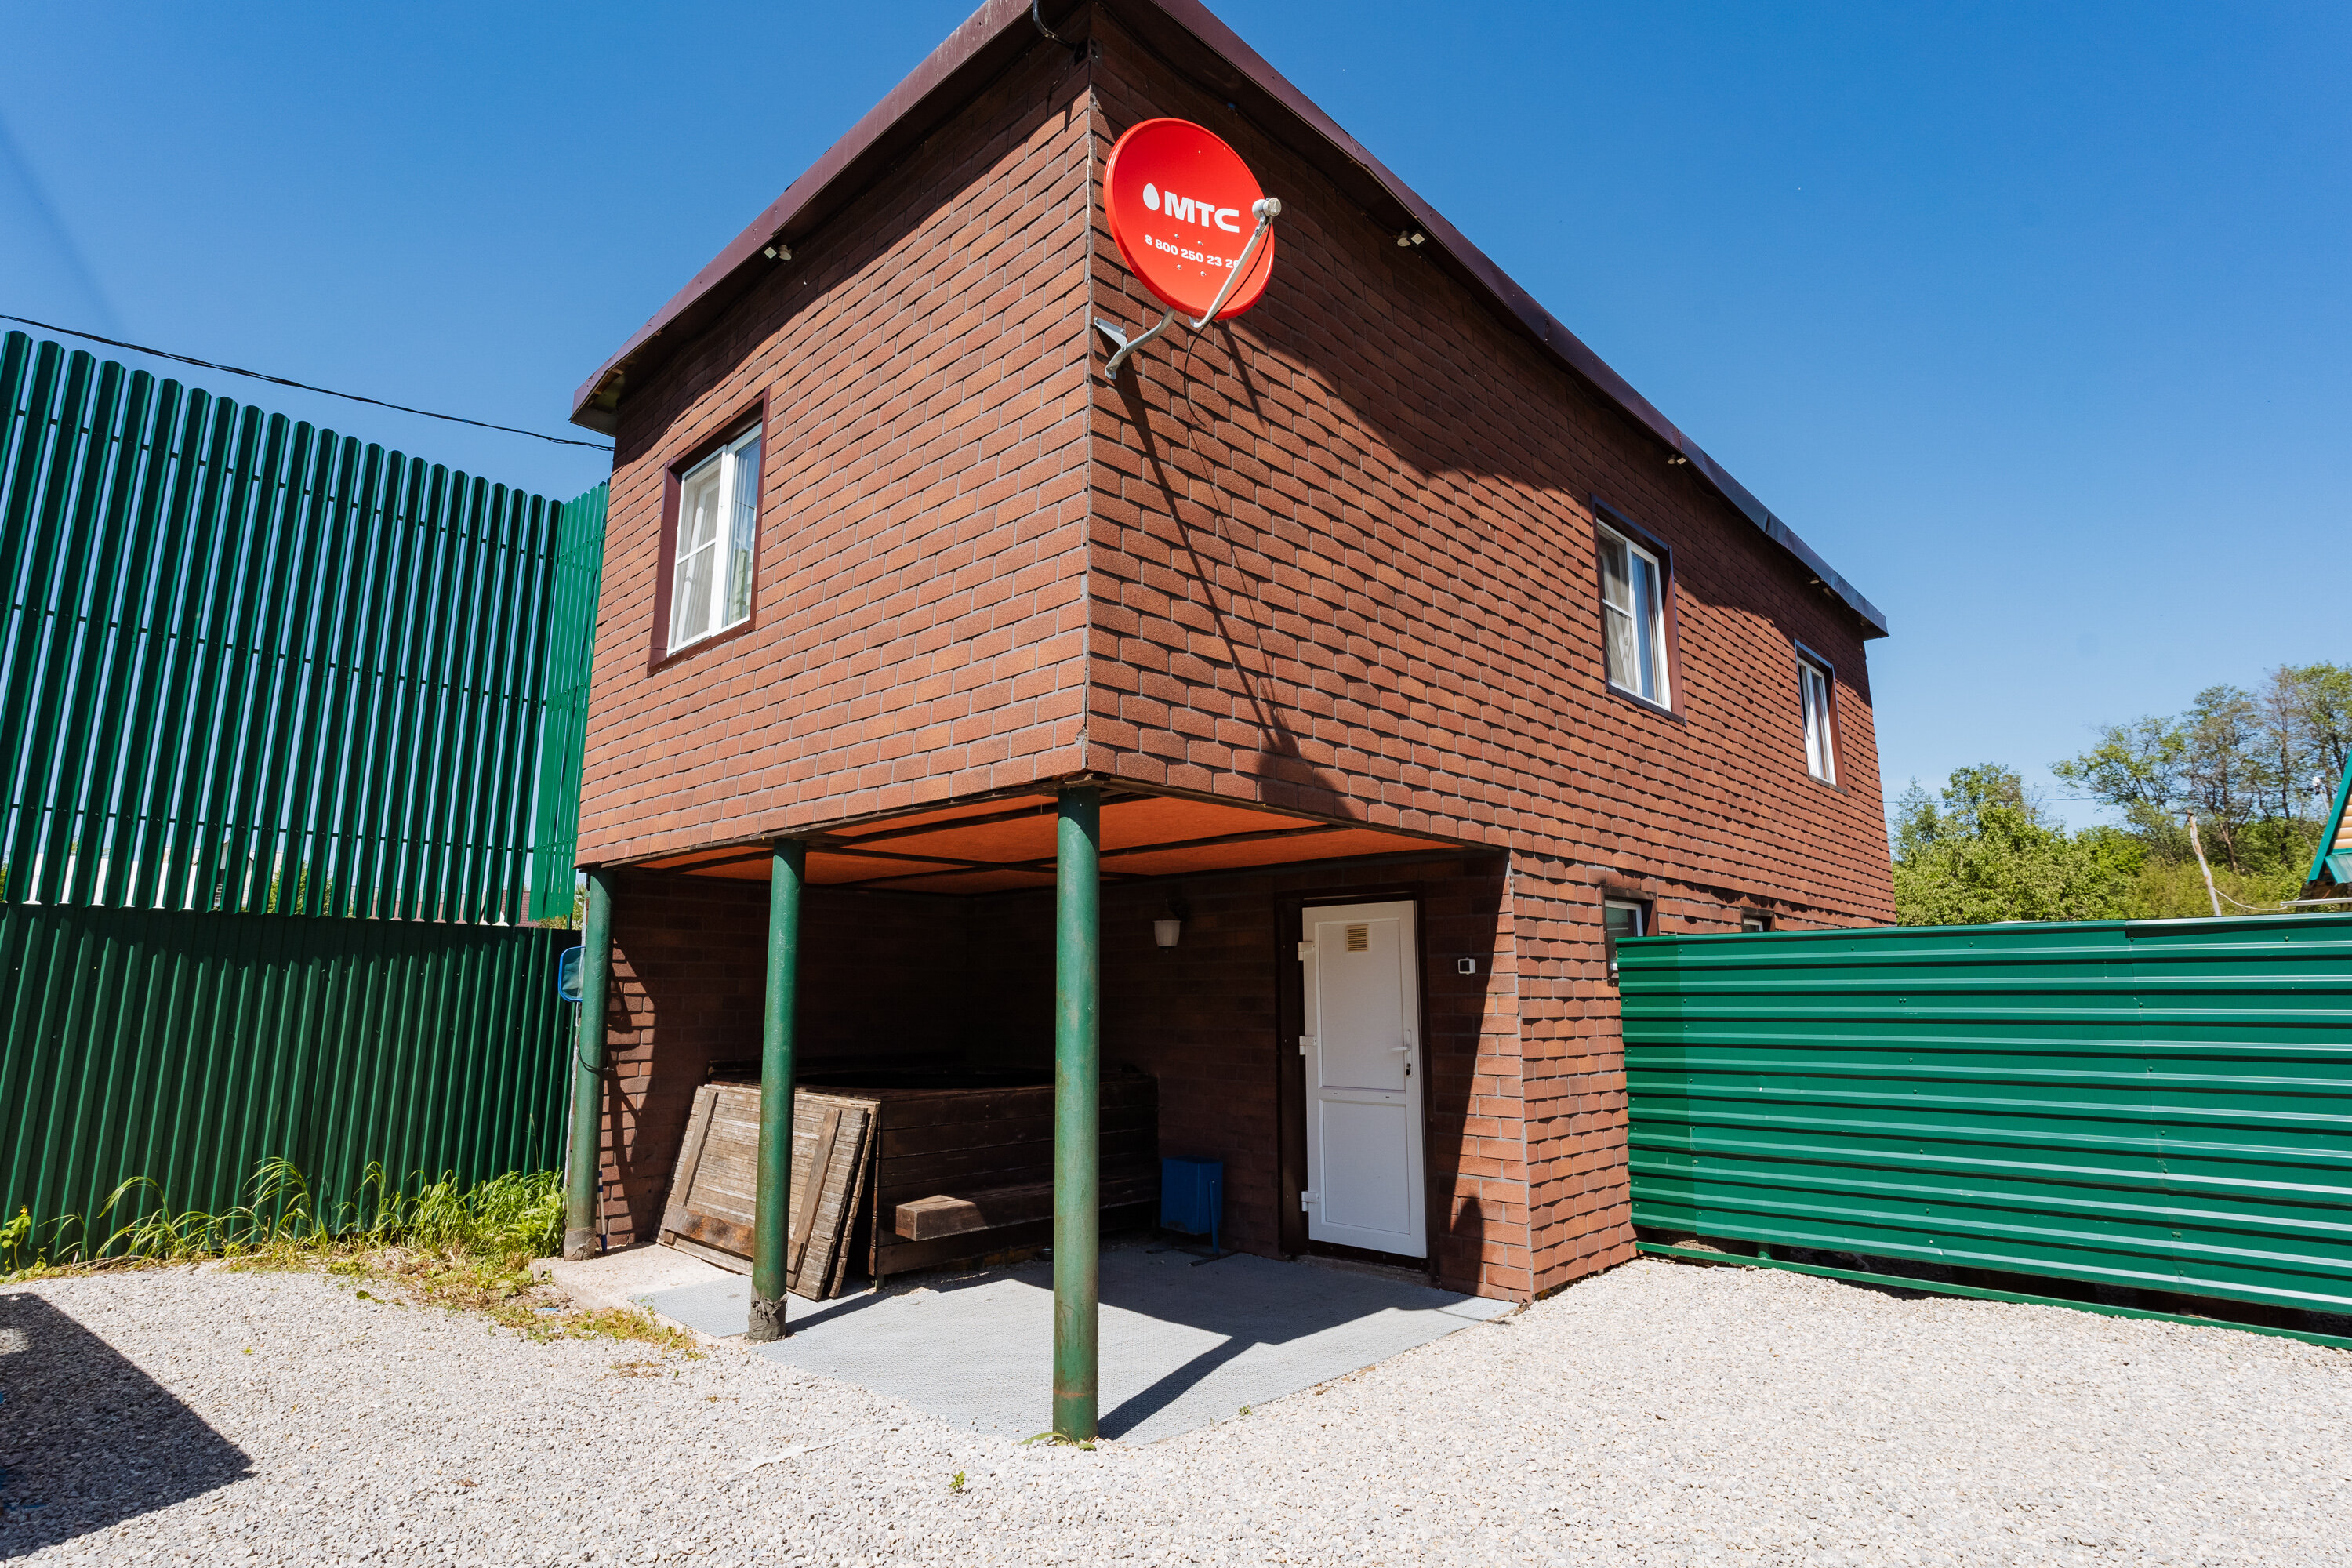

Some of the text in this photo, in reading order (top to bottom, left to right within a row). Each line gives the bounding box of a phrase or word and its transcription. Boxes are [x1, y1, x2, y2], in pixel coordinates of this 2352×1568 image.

[1164, 191, 1240, 233] МТС
[1145, 234, 1152, 245] 8
[1155, 239, 1178, 255] 800
[1181, 249, 1204, 263] 250
[1207, 255, 1223, 267] 23
